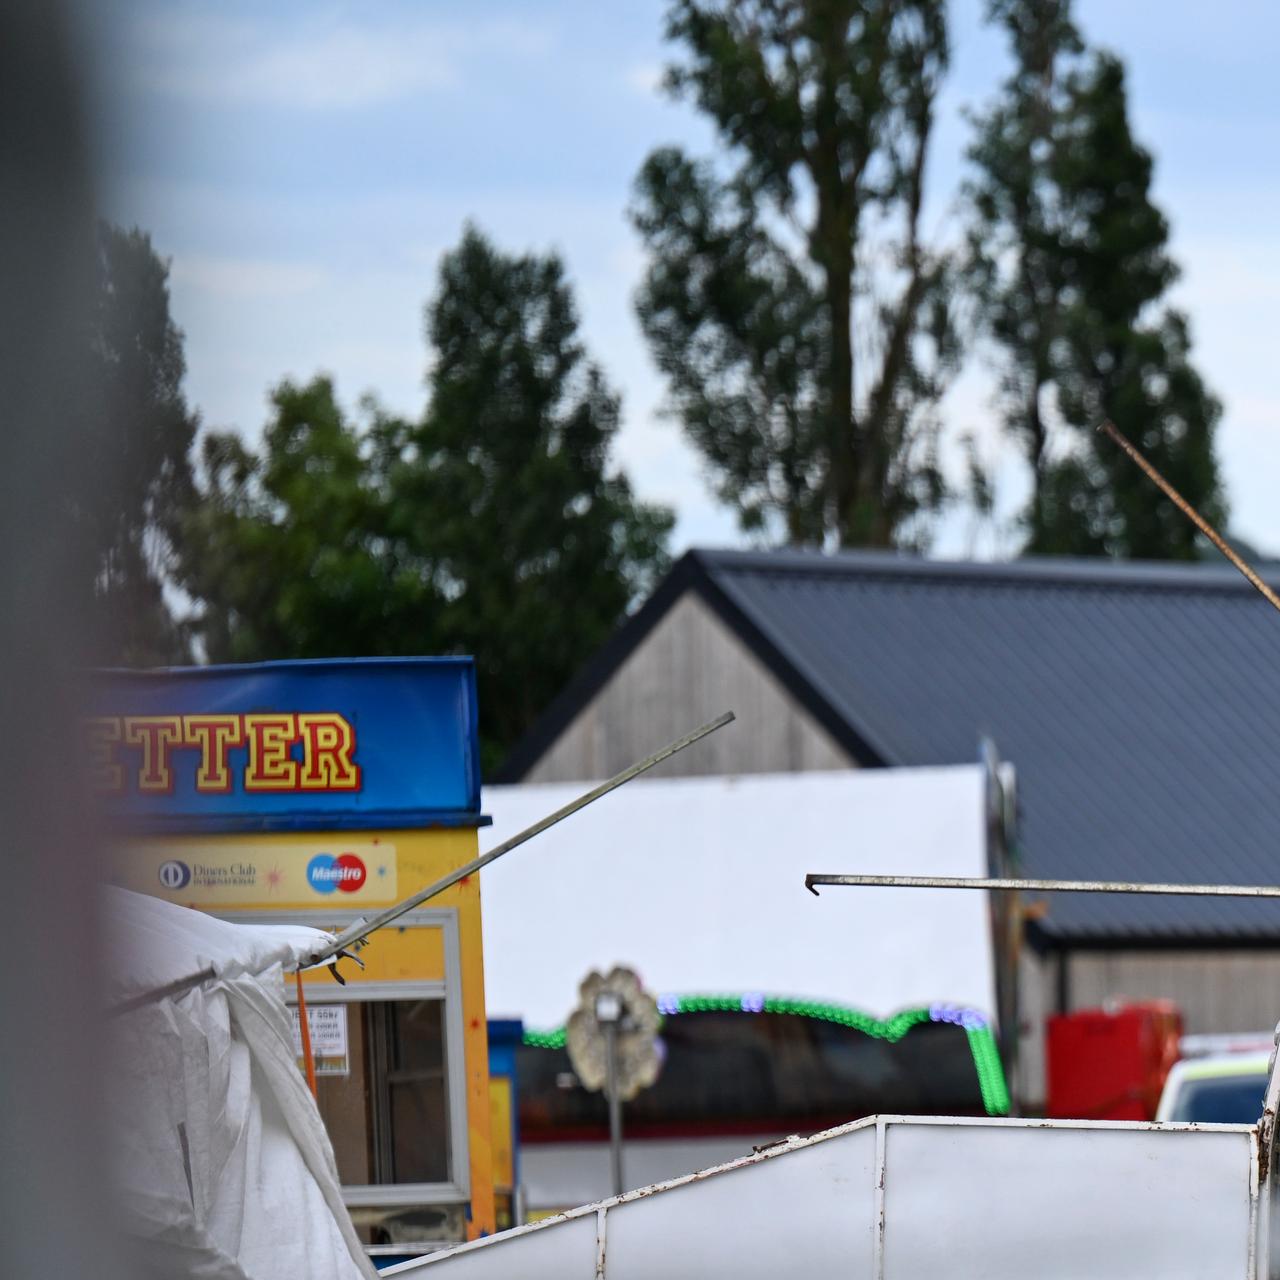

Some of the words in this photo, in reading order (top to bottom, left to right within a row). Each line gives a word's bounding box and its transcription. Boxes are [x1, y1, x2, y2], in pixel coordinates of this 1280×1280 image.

[193, 863, 228, 876] Diners
[230, 863, 256, 876] Club
[312, 867, 361, 882] Maestro
